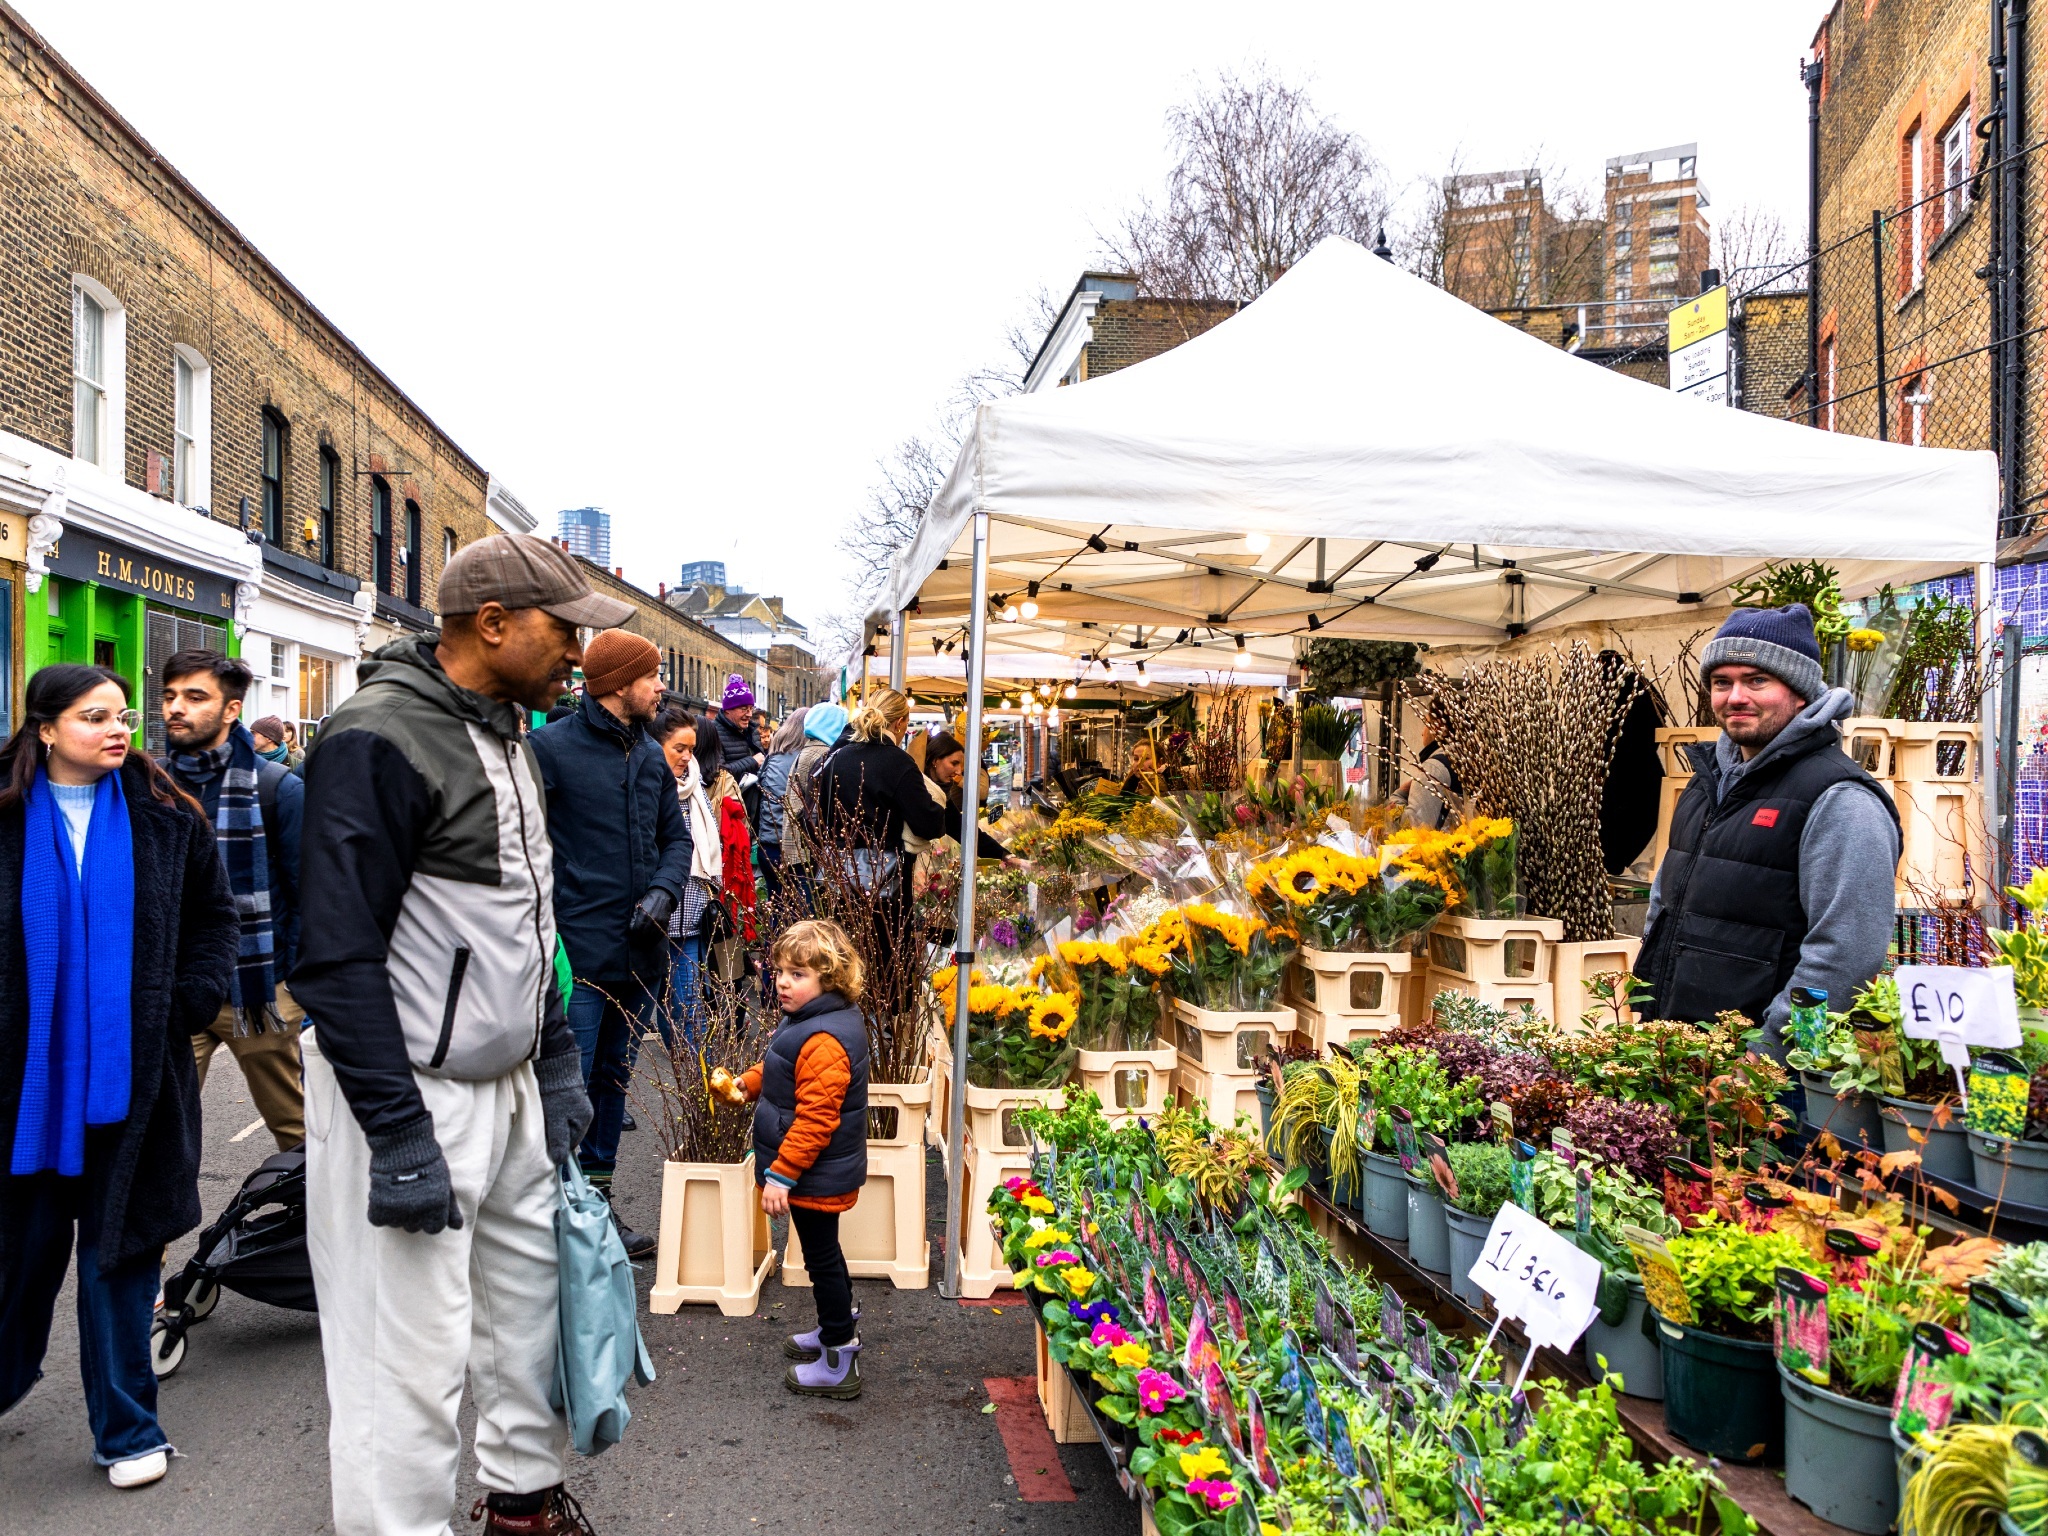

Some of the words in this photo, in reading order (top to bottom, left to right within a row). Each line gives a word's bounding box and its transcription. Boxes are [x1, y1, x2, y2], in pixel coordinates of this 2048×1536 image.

[1687, 316, 1705, 328] Sunday
[1699, 324, 1710, 335] 2pm
[1683, 354, 1691, 362] No
[1688, 359, 1706, 371] Sunday
[1684, 373, 1695, 383] 5am
[1699, 367, 1710, 378] 2pm
[220, 592, 231, 609] 114
